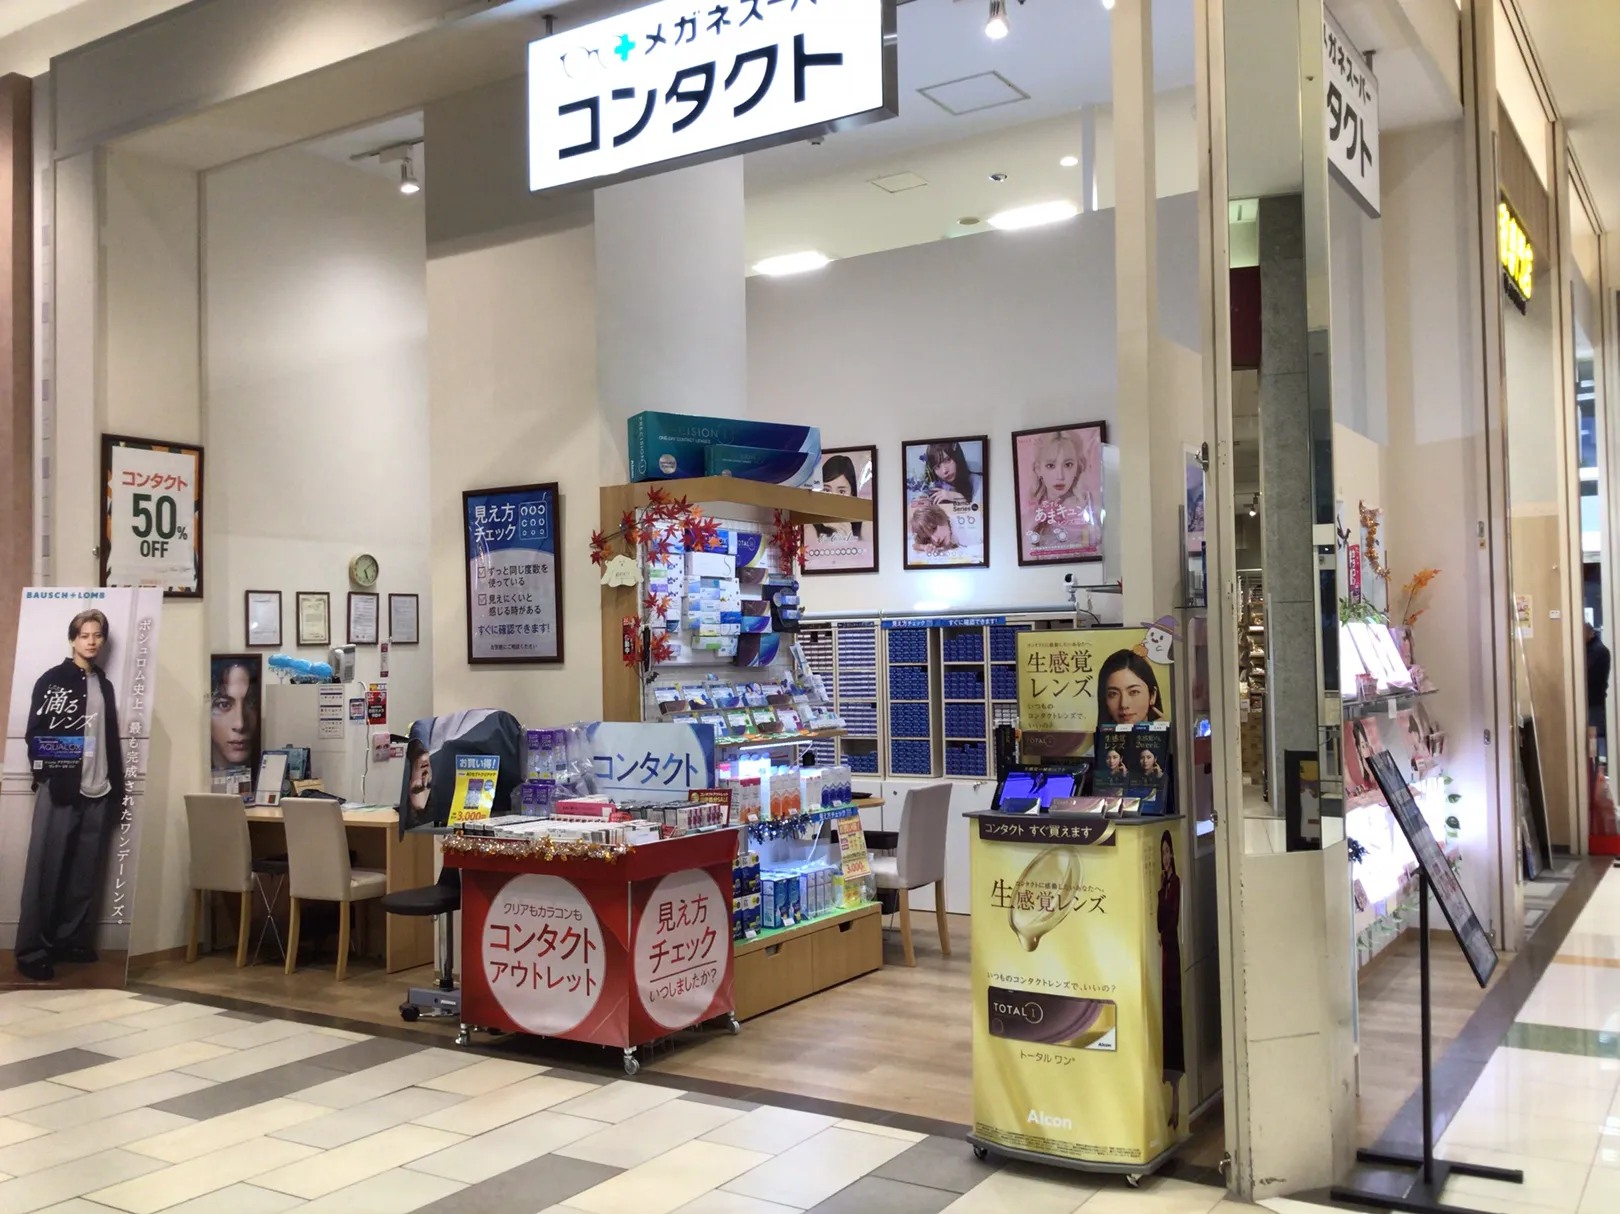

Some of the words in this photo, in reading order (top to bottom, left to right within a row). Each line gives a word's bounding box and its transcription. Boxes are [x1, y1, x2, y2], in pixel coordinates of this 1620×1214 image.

[645, 0, 817, 55] メガネスー
[559, 33, 844, 160] コンタクト
[1326, 80, 1373, 178] タクト
[122, 471, 188, 491] コンタクト
[131, 493, 188, 540] 50%
[474, 503, 516, 525] 見え方
[474, 524, 517, 543] チェック
[140, 540, 169, 558] OFF
[487, 564, 549, 577] ずっと同じ度数を
[488, 577, 525, 589] 使っている
[488, 593, 533, 604] 見えにくいと
[488, 605, 542, 617] 感じる時がある
[477, 623, 551, 636] すぐに確認できます!
[892, 620, 926, 628] 見え方チェック
[1027, 650, 1093, 674] 生感覚
[1030, 675, 1094, 698] レンズ
[36, 688, 79, 715] 滴る
[49, 712, 98, 731] レンズ
[460, 758, 497, 769] お買い得!
[593, 751, 698, 787] コンタクト
[984, 822, 1025, 834] コンタクト
[1029, 825, 1093, 838] すぐ買えます
[990, 878, 1108, 914] 生感覚レンズ
[503, 902, 583, 921] クリアもカラコンも
[656, 893, 709, 935] 見え方
[490, 923, 597, 964] コンタクト
[649, 926, 717, 973] チェック
[489, 960, 597, 996] アウトレット
[650, 968, 718, 1003] いつしましたか?
[986, 972, 1117, 992] いつものコンタクトレンズで、いいの?
[1020, 1052, 1052, 1063] トータル
[1026, 1109, 1073, 1130] Alcon
